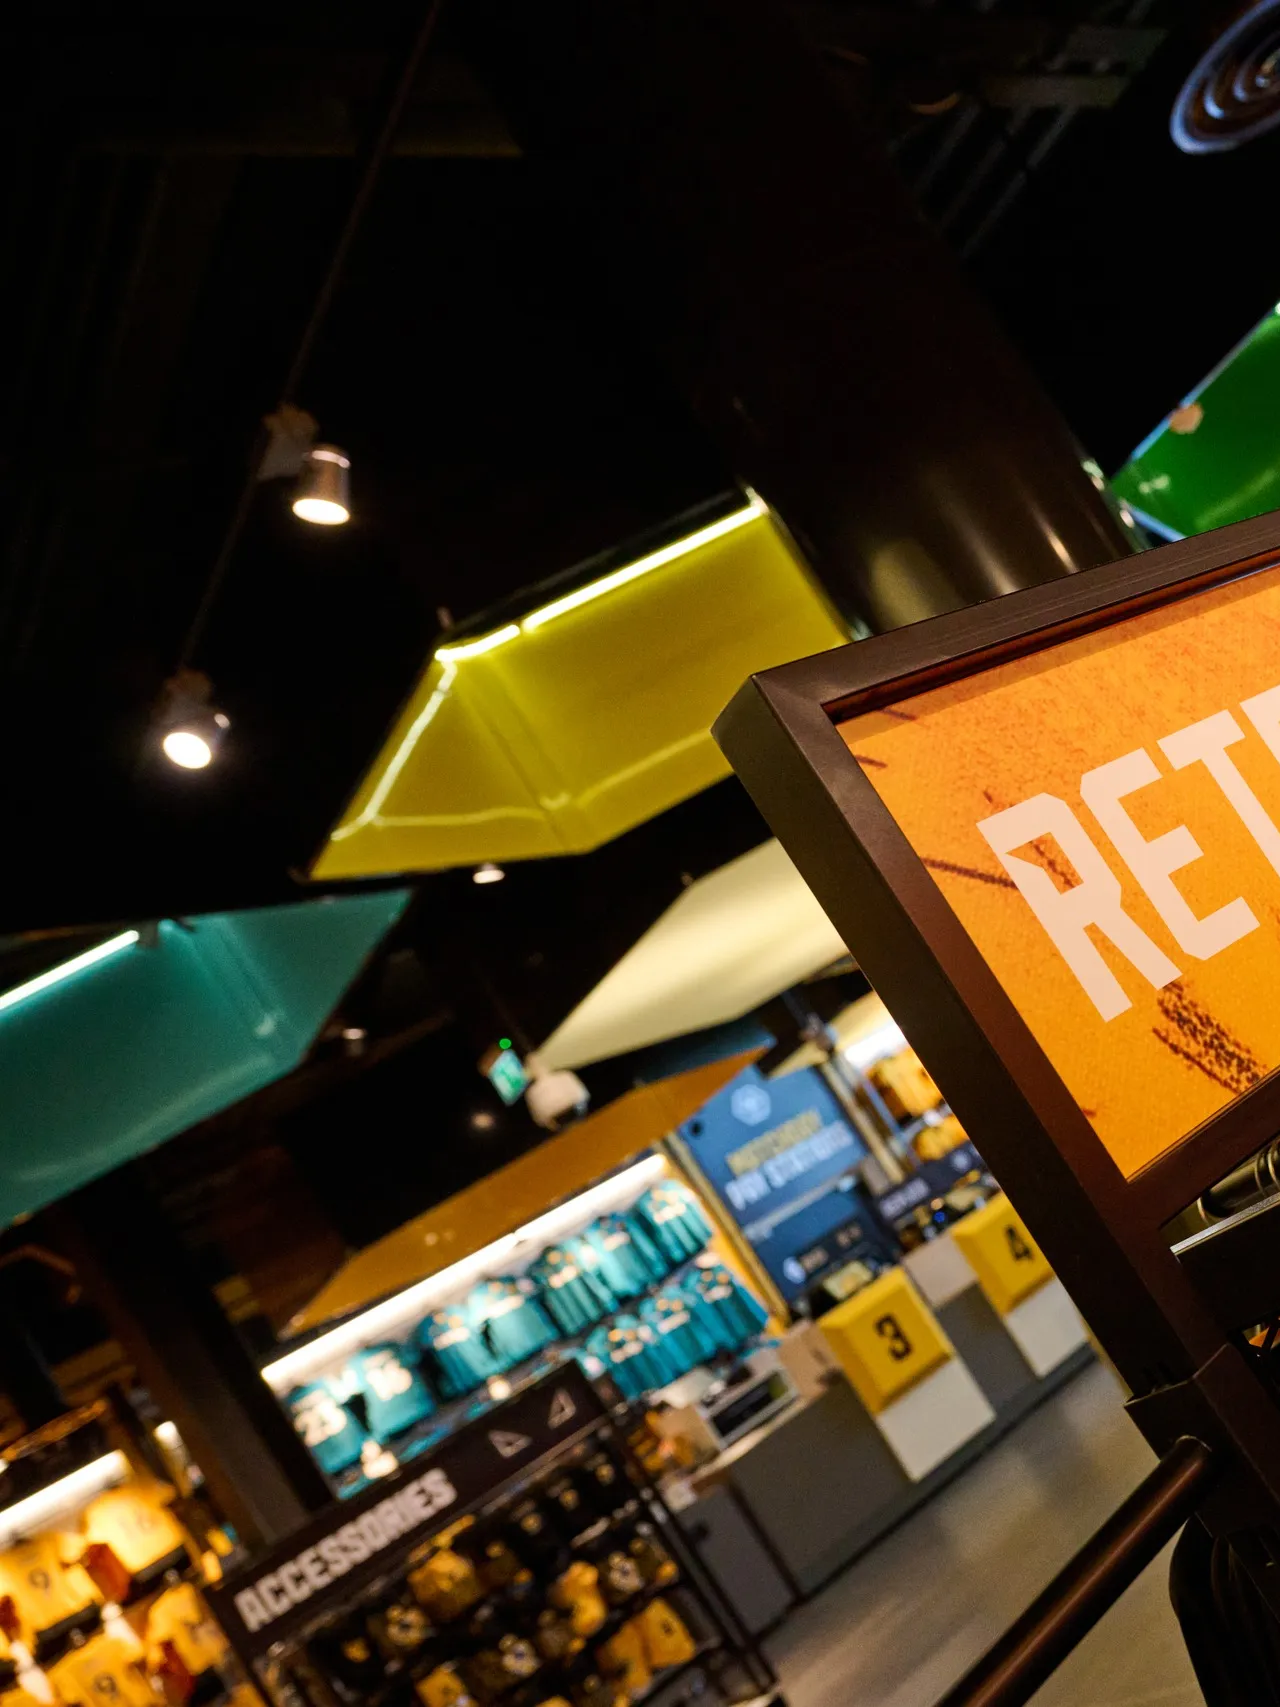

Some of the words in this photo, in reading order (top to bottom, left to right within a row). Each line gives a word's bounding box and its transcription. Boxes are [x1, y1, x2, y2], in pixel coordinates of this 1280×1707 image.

[1005, 1224, 1035, 1262] 4
[874, 1312, 913, 1362] 3
[233, 1467, 458, 1634] ACCESSORIES
